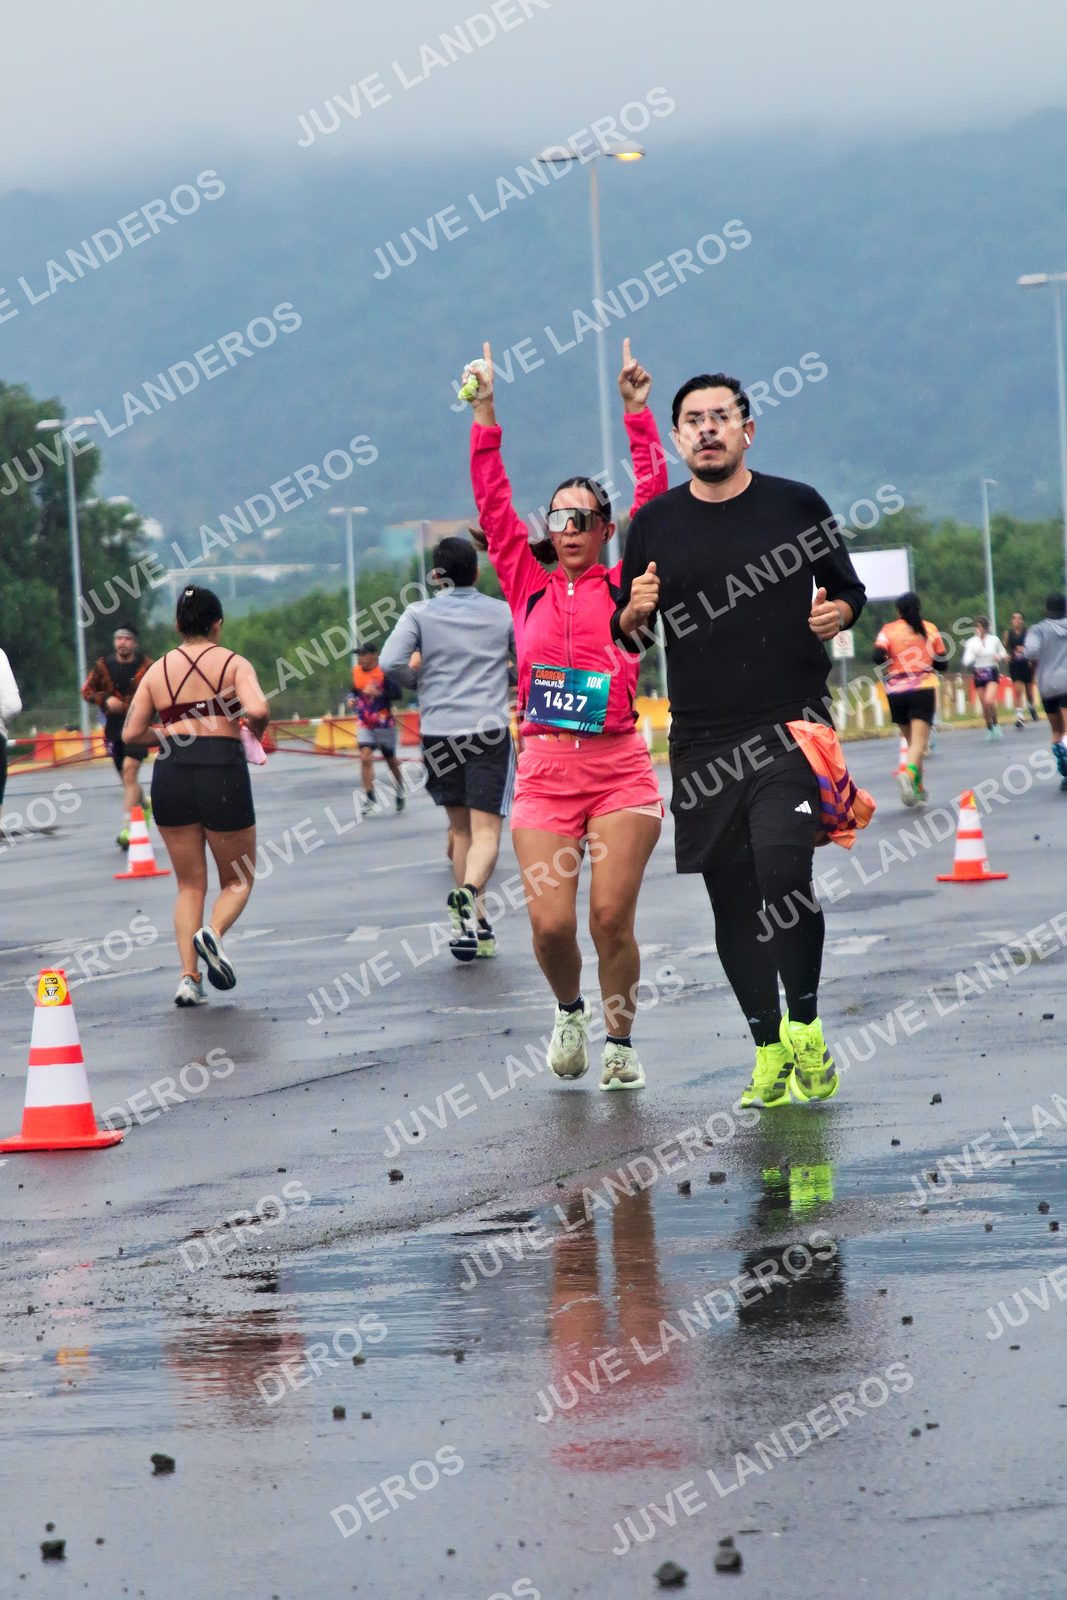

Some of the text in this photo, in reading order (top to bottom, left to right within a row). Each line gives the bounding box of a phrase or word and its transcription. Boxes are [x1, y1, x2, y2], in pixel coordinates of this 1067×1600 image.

[535, 669, 566, 681] CARRERA
[586, 675, 604, 689] 10K
[543, 690, 588, 712] 1427
